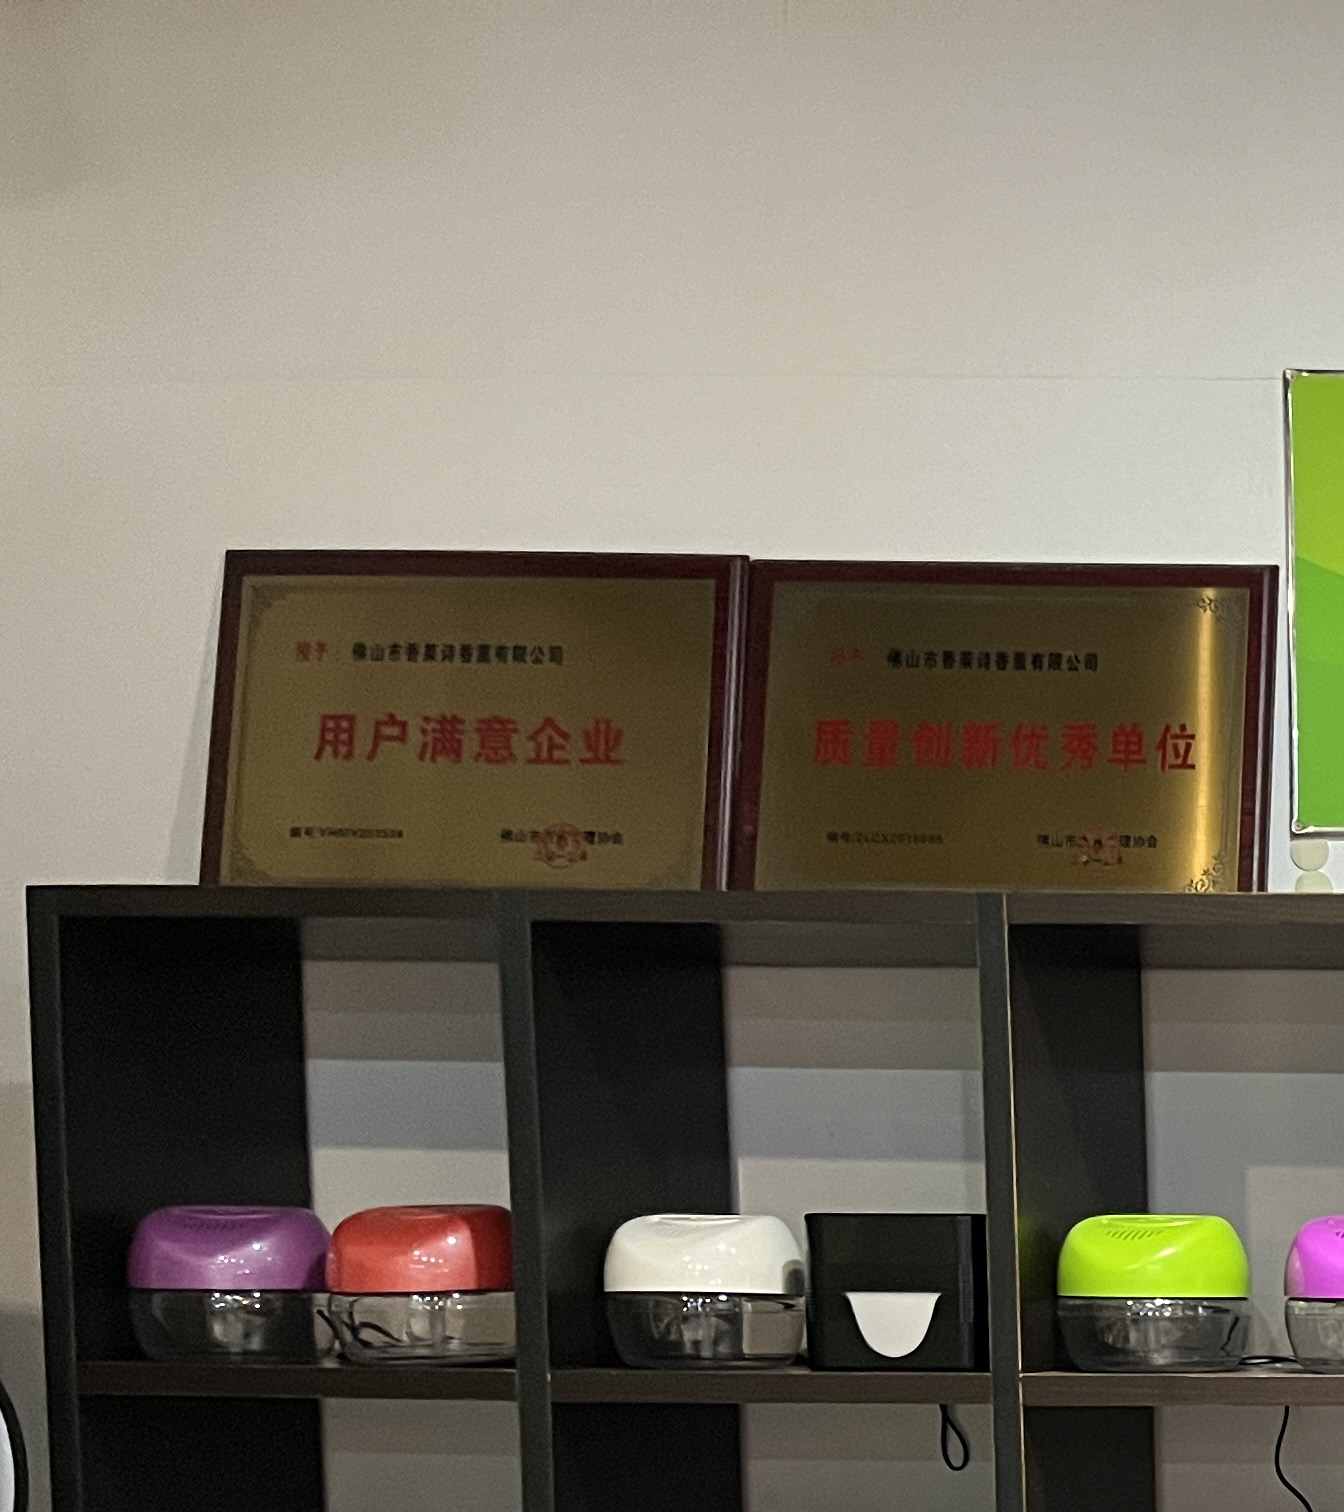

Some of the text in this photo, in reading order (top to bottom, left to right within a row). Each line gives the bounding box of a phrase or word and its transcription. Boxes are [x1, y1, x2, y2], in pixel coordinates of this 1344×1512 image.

[313, 712, 625, 767] 用户满意企业
[810, 717, 1197, 772] 质量创新优秀单位
